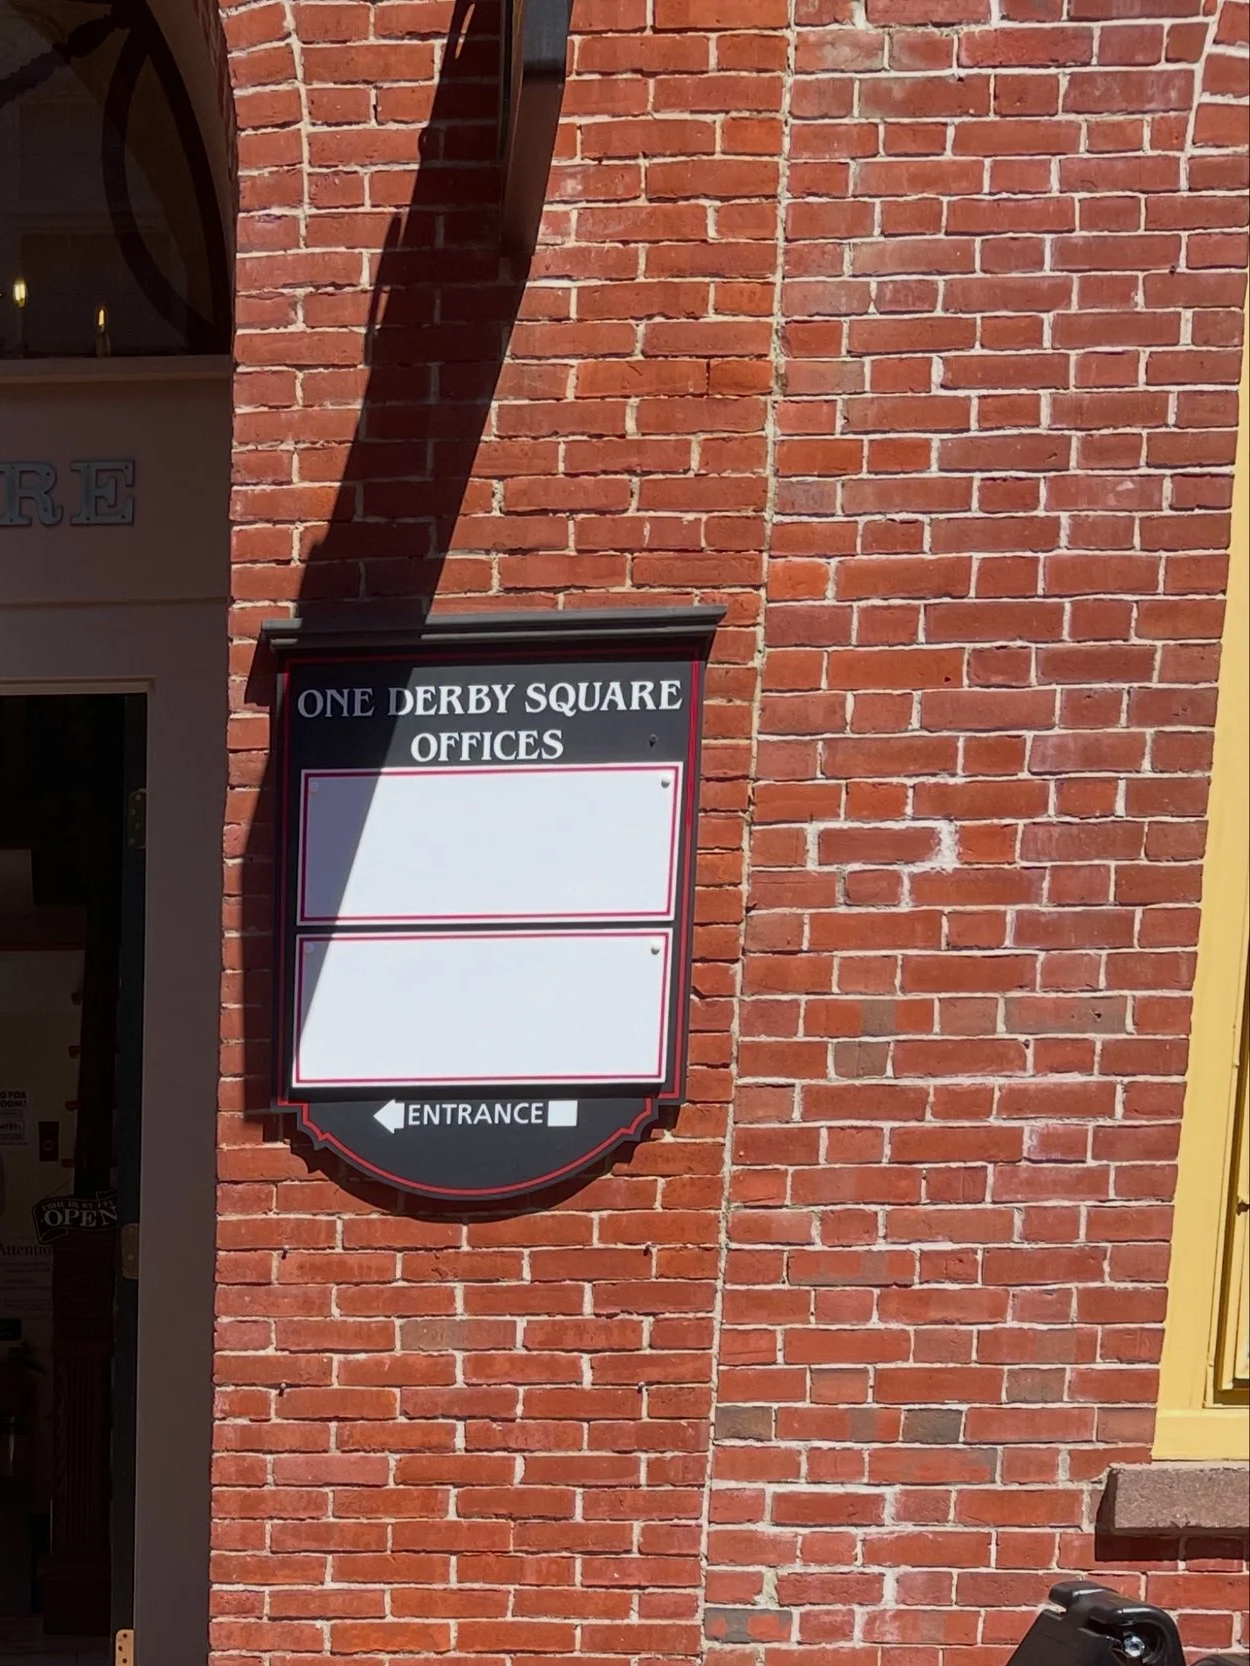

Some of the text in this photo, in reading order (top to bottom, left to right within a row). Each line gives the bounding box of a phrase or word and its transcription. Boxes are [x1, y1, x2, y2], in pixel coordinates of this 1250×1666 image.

[297, 679, 683, 718] ONE DERBY SQUARE
[410, 728, 565, 763] OFFICES
[408, 1101, 545, 1126] ENTRANCE
[44, 1205, 118, 1228] OPEN
